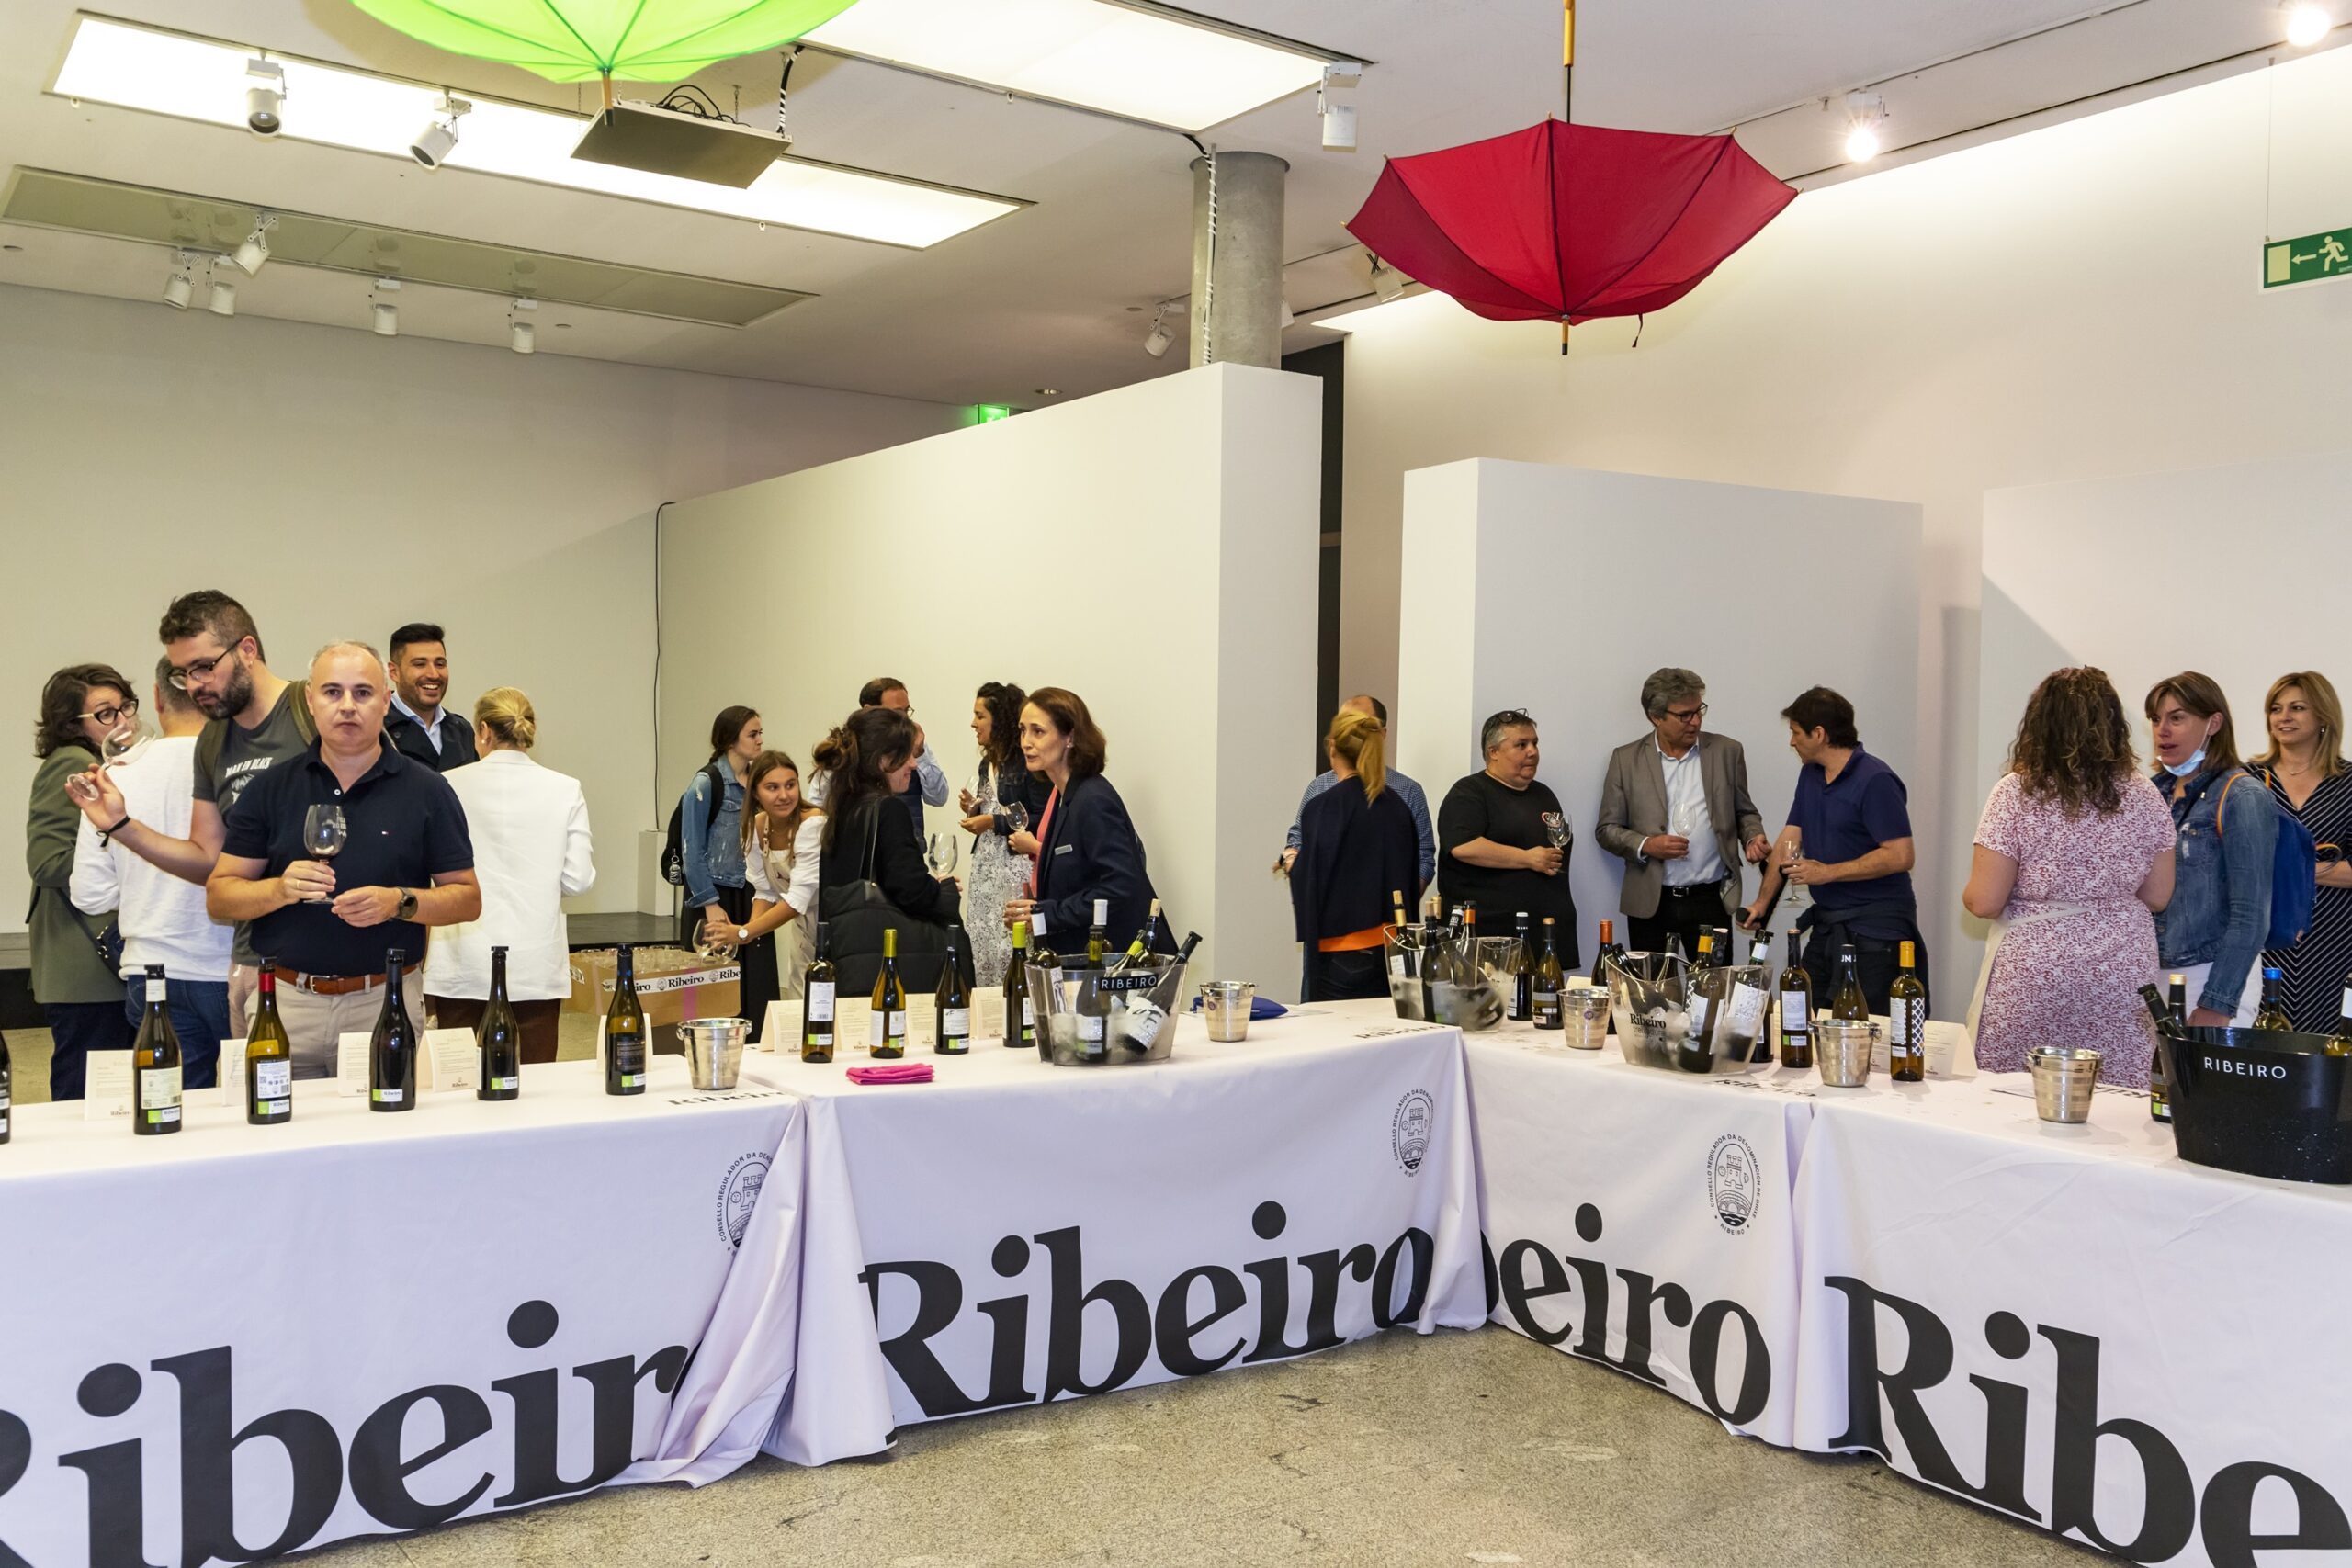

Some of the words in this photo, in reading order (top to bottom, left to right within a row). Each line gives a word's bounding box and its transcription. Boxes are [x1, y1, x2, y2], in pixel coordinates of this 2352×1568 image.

[668, 976, 705, 988] Ribeiro
[1101, 976, 1158, 989] RIBEIRO
[1629, 1013, 1667, 1029] Ribeiro
[2204, 1057, 2287, 1079] RIBEIRO
[1707, 1134, 1726, 1169] REGULADOR
[718, 1156, 745, 1201] REGULADOR
[717, 1201, 727, 1242] CONSELLO
[1720, 1223, 1745, 1235] RIBEIRO
[857, 1201, 1435, 1419] Ribeiro
